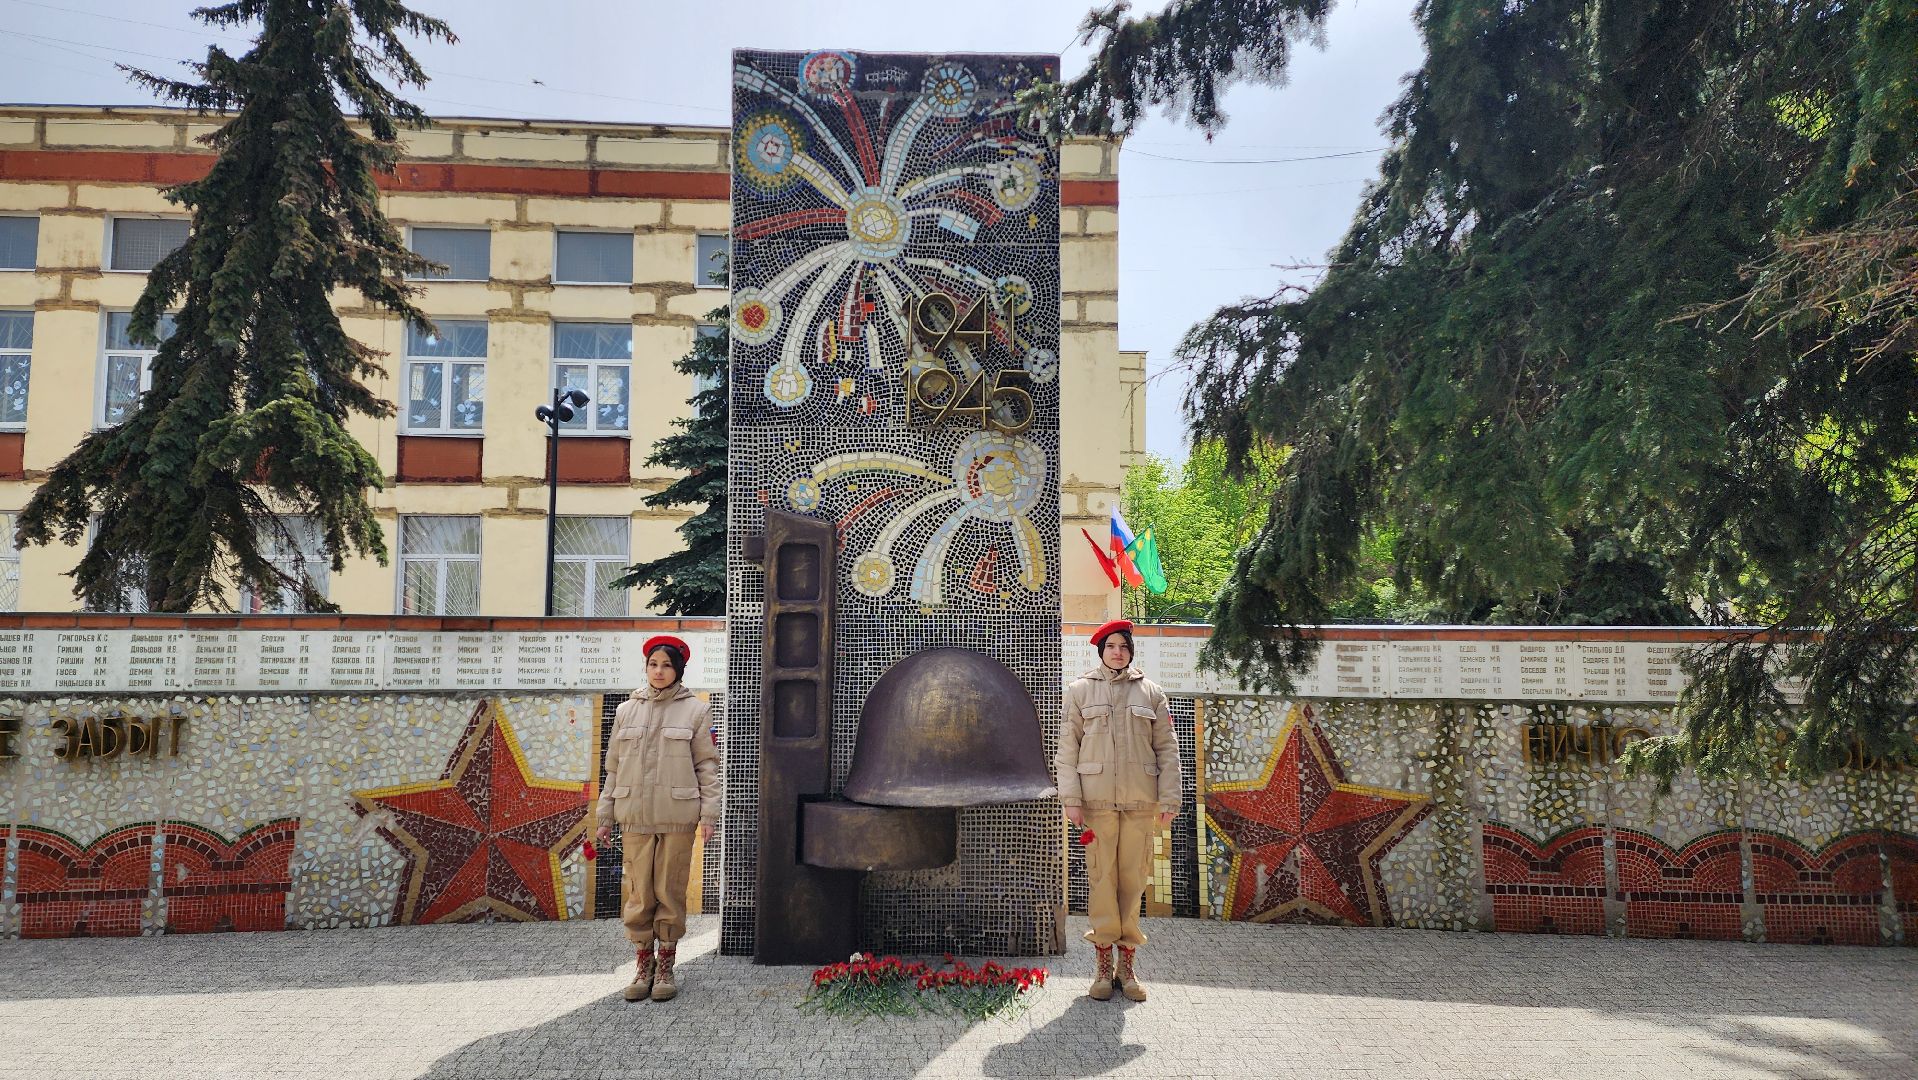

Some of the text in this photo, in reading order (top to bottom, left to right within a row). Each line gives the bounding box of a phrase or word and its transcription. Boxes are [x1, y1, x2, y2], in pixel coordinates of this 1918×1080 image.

[901, 292, 1015, 352] 1941
[899, 367, 1034, 430] 1945
[51, 716, 189, 761] ЗАБЫТ
